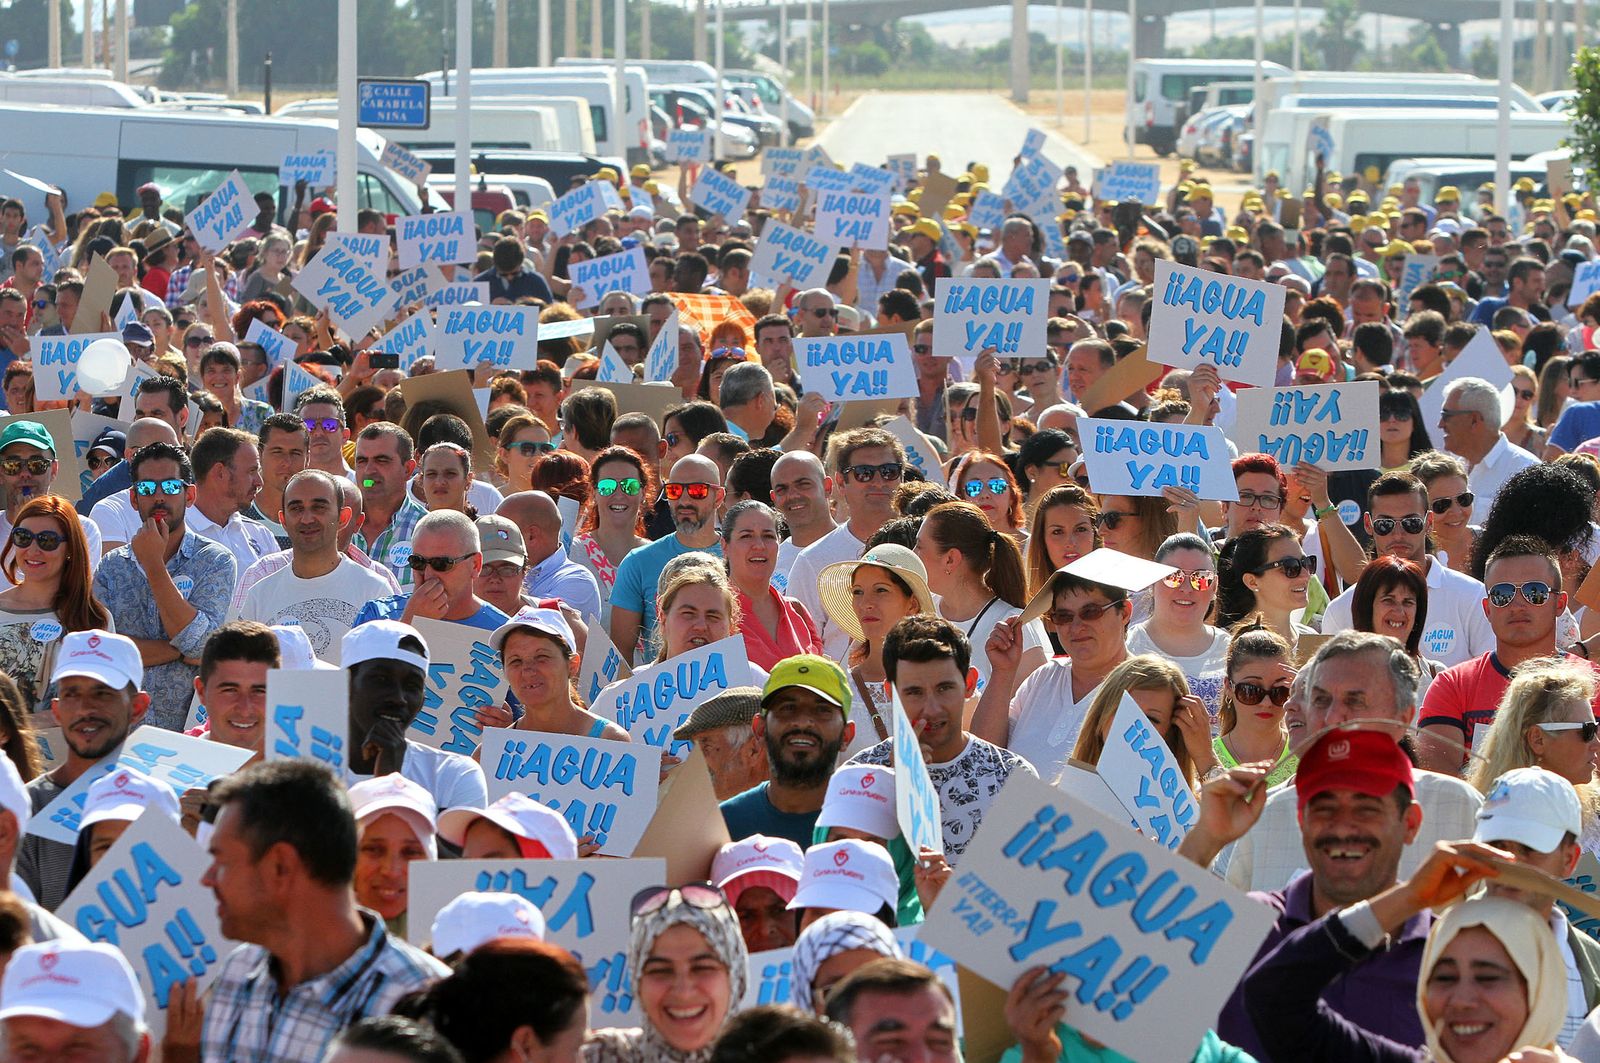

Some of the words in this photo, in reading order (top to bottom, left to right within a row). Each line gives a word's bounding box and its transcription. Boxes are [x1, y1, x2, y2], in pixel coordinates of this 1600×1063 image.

[361, 99, 424, 109] CARABELA
[374, 87, 412, 97] CALLE
[194, 180, 239, 231] ¡¡AGUA
[212, 202, 244, 241] YA!!
[822, 194, 882, 218] ¡¡AGUA
[403, 215, 464, 240] ¡¡AGUA
[834, 217, 874, 241] YA!!
[418, 240, 459, 263] YA!!
[767, 226, 829, 268] ¡¡AGUA
[322, 248, 387, 308] ¡¡AGUA
[577, 254, 636, 284] ¡¡AGUA
[771, 251, 814, 283] YA!!
[317, 276, 364, 321] YA!!
[944, 285, 1035, 316] ¡¡AGUA
[1163, 271, 1266, 327] ¡¡AGUA
[445, 311, 525, 335] ¡¡AGUA
[965, 319, 1025, 353] YA!!
[462, 339, 516, 366] YA!!
[807, 339, 895, 368] ¡¡AGUA
[1182, 316, 1250, 368] YA!!
[830, 369, 888, 397] YA!!
[1095, 425, 1210, 460] ¡¡AGUA
[1126, 459, 1201, 494] YA!!
[391, 546, 412, 555] ¡¡AGU
[1424, 629, 1454, 643] ¡¡AGUA
[1431, 642, 1449, 653] YA!!
[616, 652, 728, 731] ¡¡AGUA
[495, 739, 637, 797] ¡¡AGUA
[1001, 804, 1235, 967] ¡¡AGUA
[951, 897, 994, 937] YA!!
[956, 871, 1028, 936] ¡¡TIERRA
[1008, 898, 1170, 1022] YA!!
